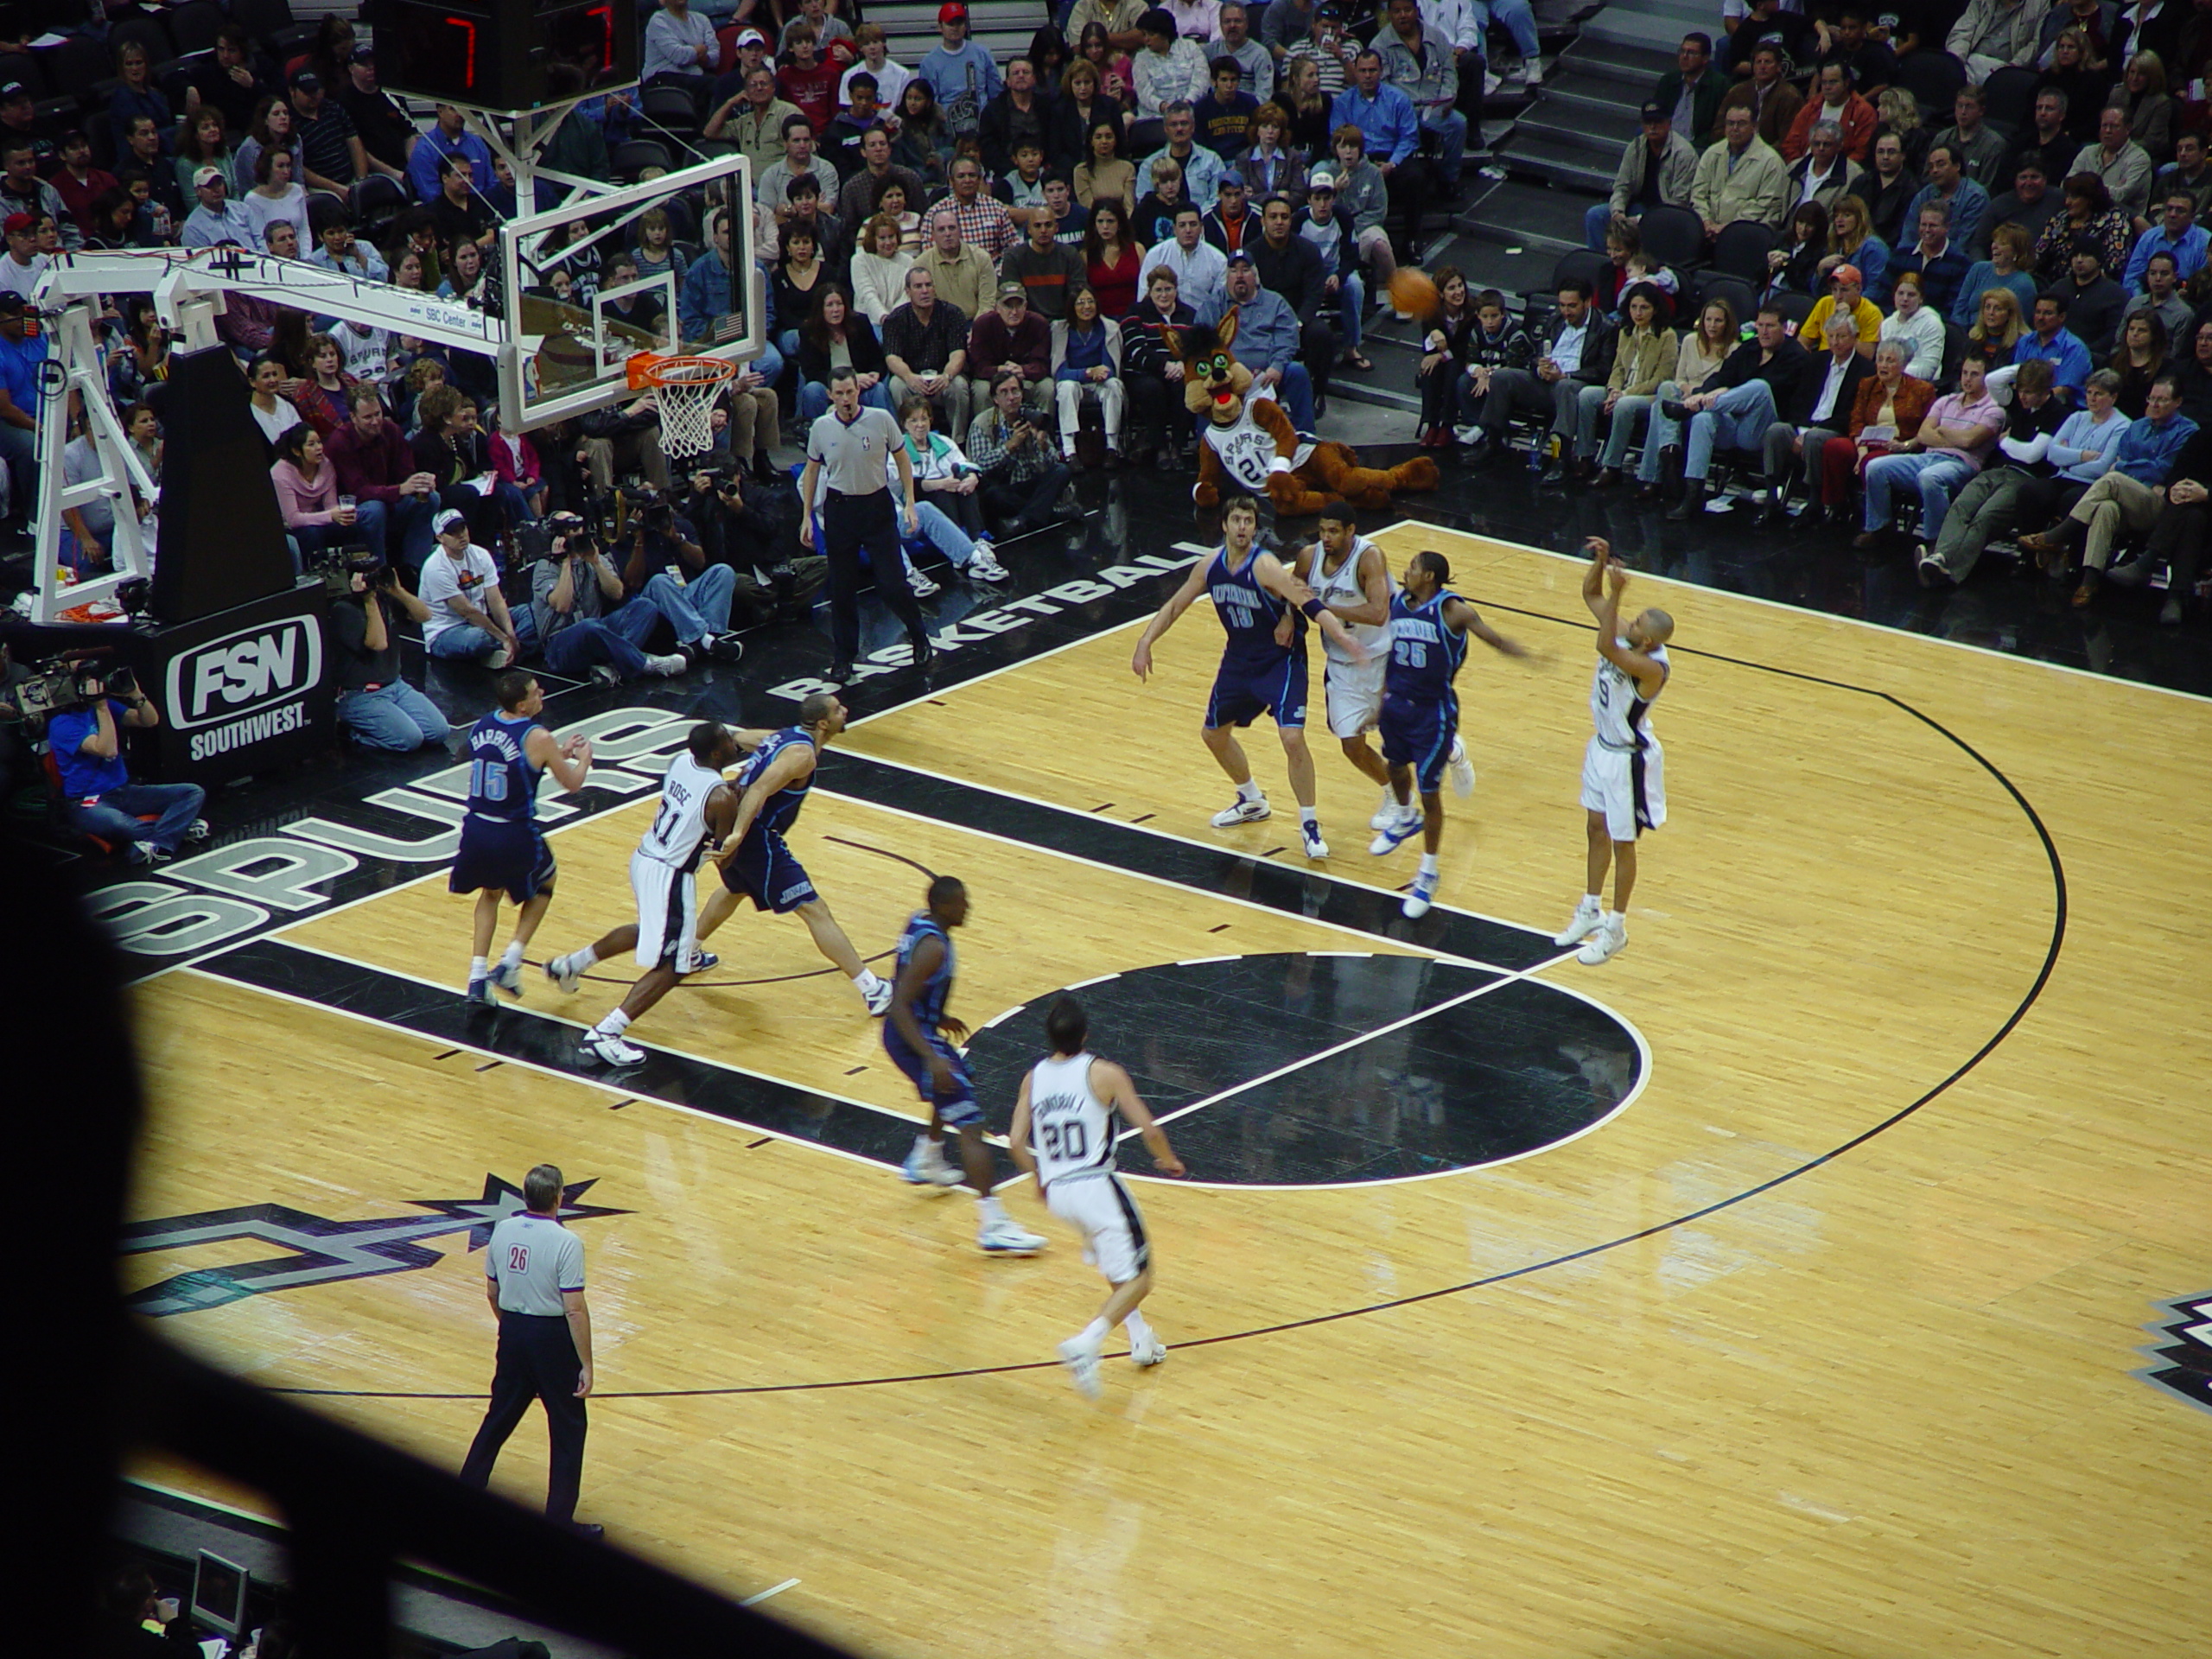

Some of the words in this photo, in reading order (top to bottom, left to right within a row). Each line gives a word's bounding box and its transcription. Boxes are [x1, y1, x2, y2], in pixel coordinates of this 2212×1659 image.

[426, 307, 442, 323] SBC
[442, 311, 466, 327] Center
[1224, 432, 1265, 466] SPURS
[192, 626, 297, 716] FSN
[1394, 640, 1427, 669] 25
[1599, 677, 1609, 709] 9
[190, 701, 305, 761] SOUTHWEST
[471, 758, 509, 802] 15
[668, 779, 692, 808] ROSE
[1042, 1120, 1086, 1160] 20
[509, 1246, 528, 1271] 26
